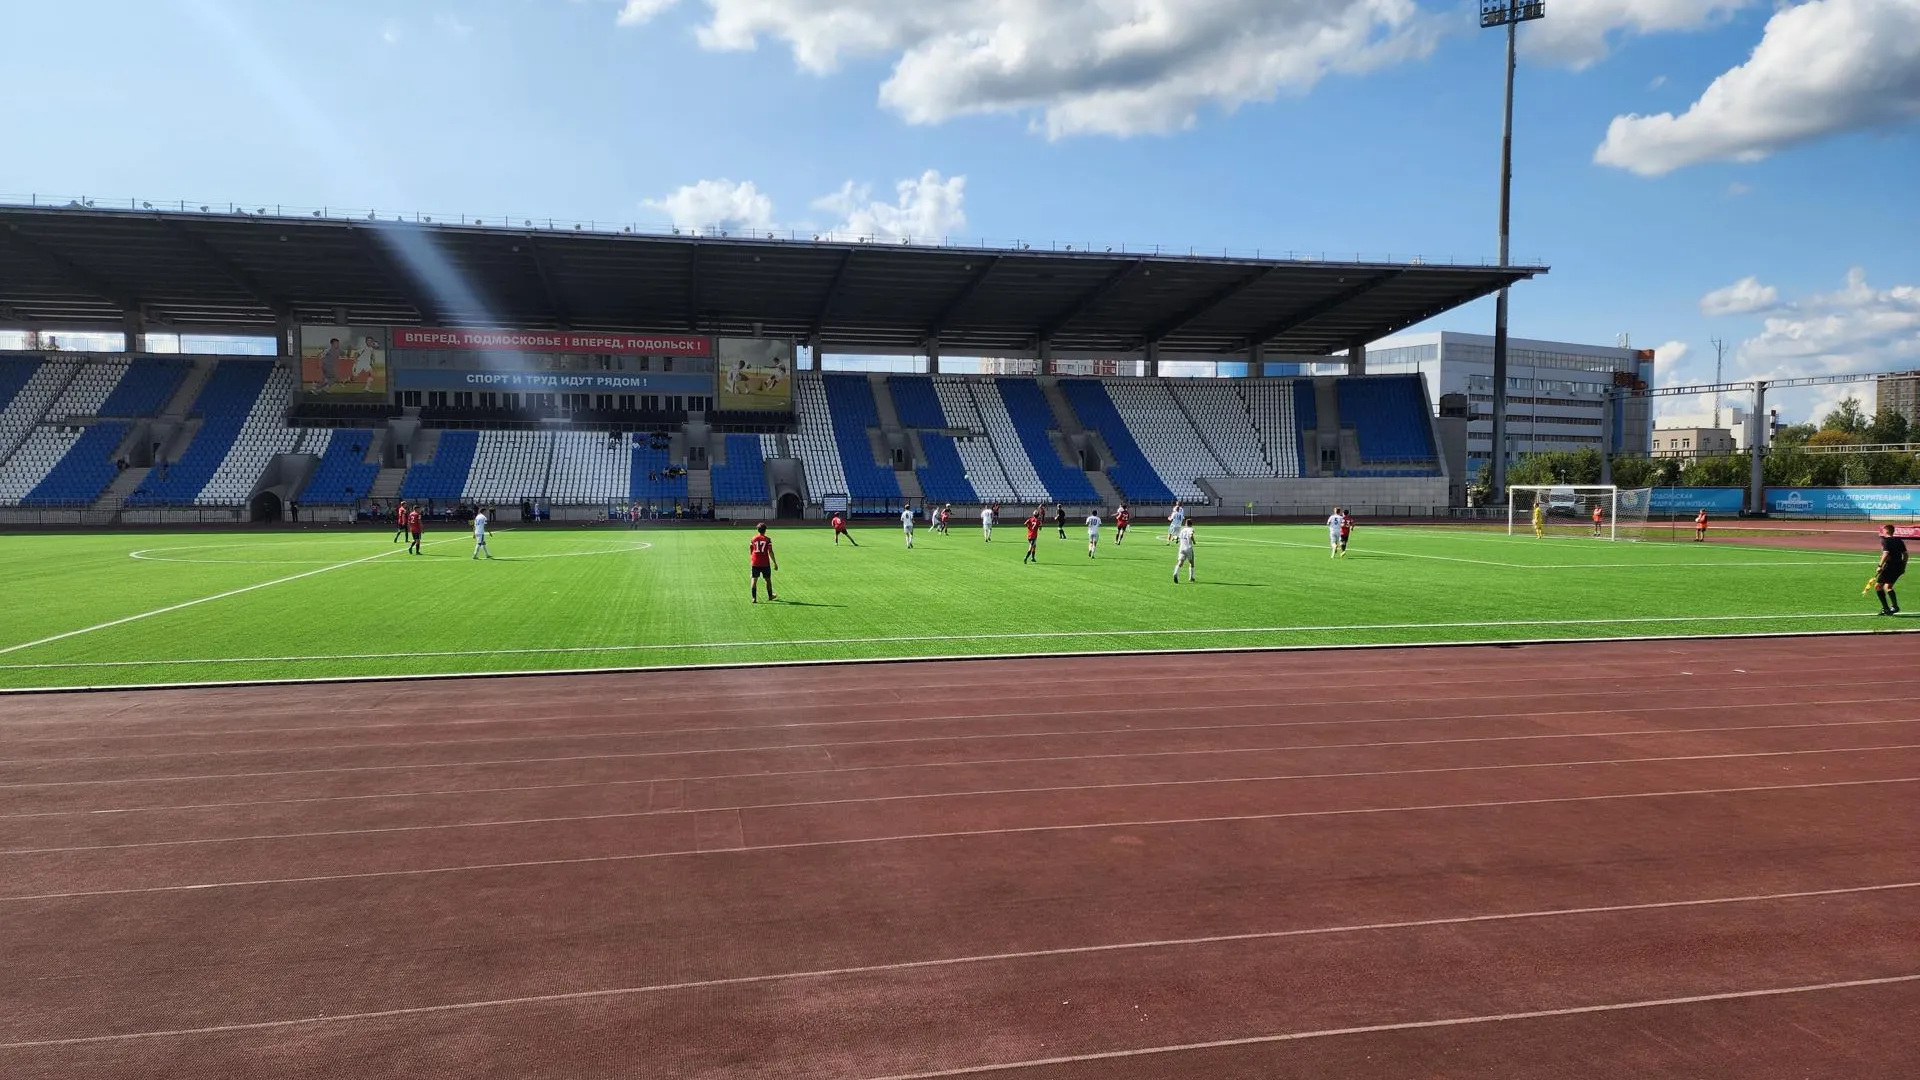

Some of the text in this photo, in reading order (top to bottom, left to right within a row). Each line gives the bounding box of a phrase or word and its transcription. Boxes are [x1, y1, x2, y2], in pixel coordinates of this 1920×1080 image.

[405, 333, 461, 345] ВПЕРЕД,
[464, 335, 561, 346] ПОДМОСКОВЬЕ
[571, 338, 624, 348] ВПЕРЕД,
[627, 340, 694, 349] ПОДОЛЬСК
[466, 374, 509, 384] СПОРТ
[512, 376, 522, 384] И
[525, 376, 557, 386] ТРУД
[560, 377, 593, 387] ИДУТ
[597, 378, 640, 387] РЯДОМ
[1827, 493, 1911, 501] БЛАГОТВОРИТЕЛЬНЫЙ
[754, 540, 767, 553] 17
